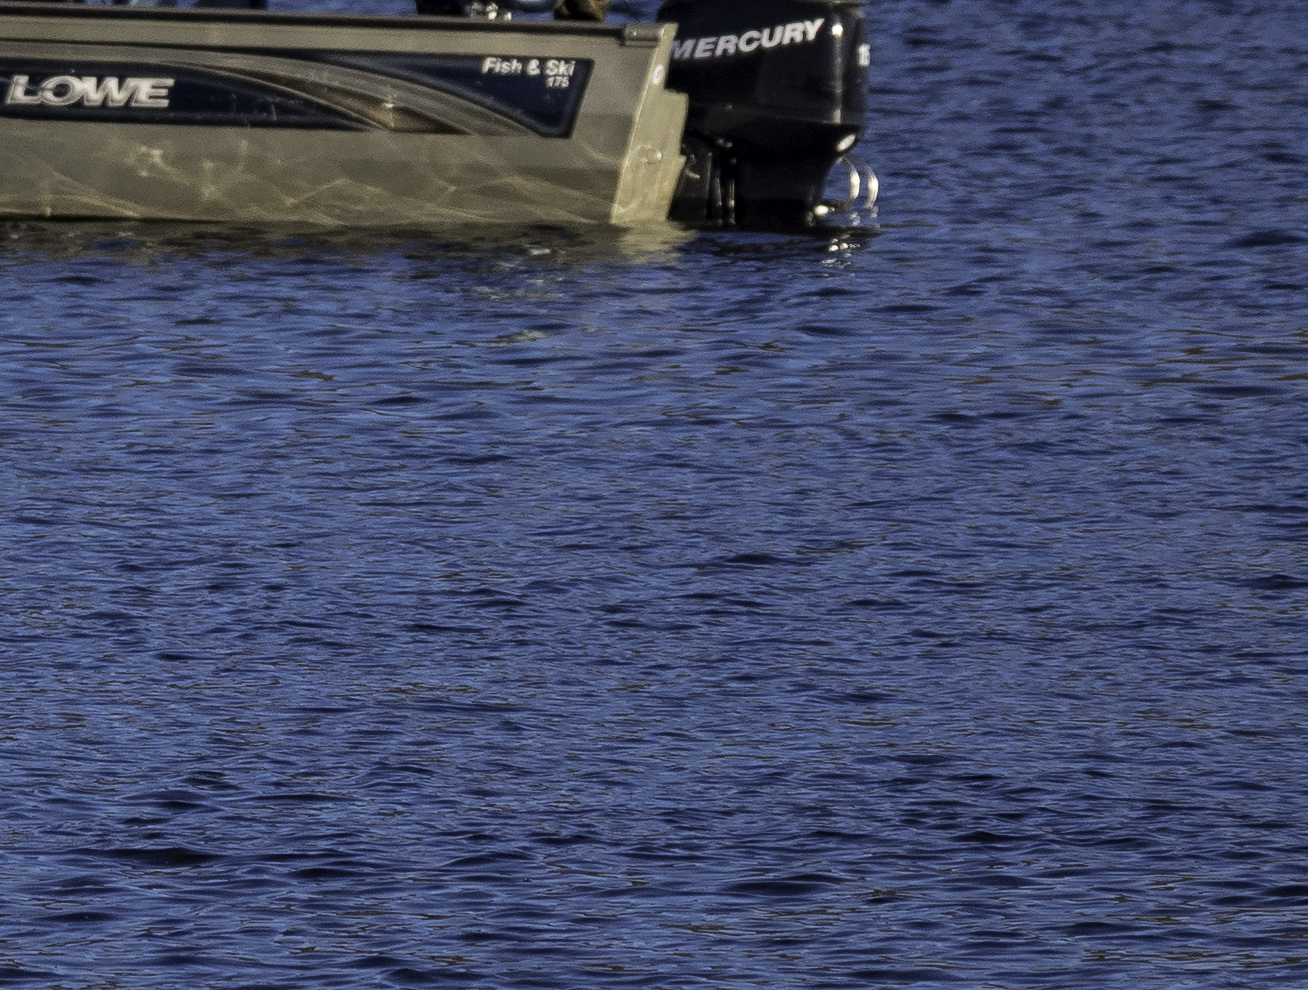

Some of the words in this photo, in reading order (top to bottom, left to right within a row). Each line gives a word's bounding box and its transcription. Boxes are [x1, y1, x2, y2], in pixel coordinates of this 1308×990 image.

[671, 18, 825, 60] MERCURY
[481, 56, 523, 74] Fish
[526, 58, 541, 76] &
[545, 59, 576, 76] Ski
[5, 74, 176, 108] LOWE
